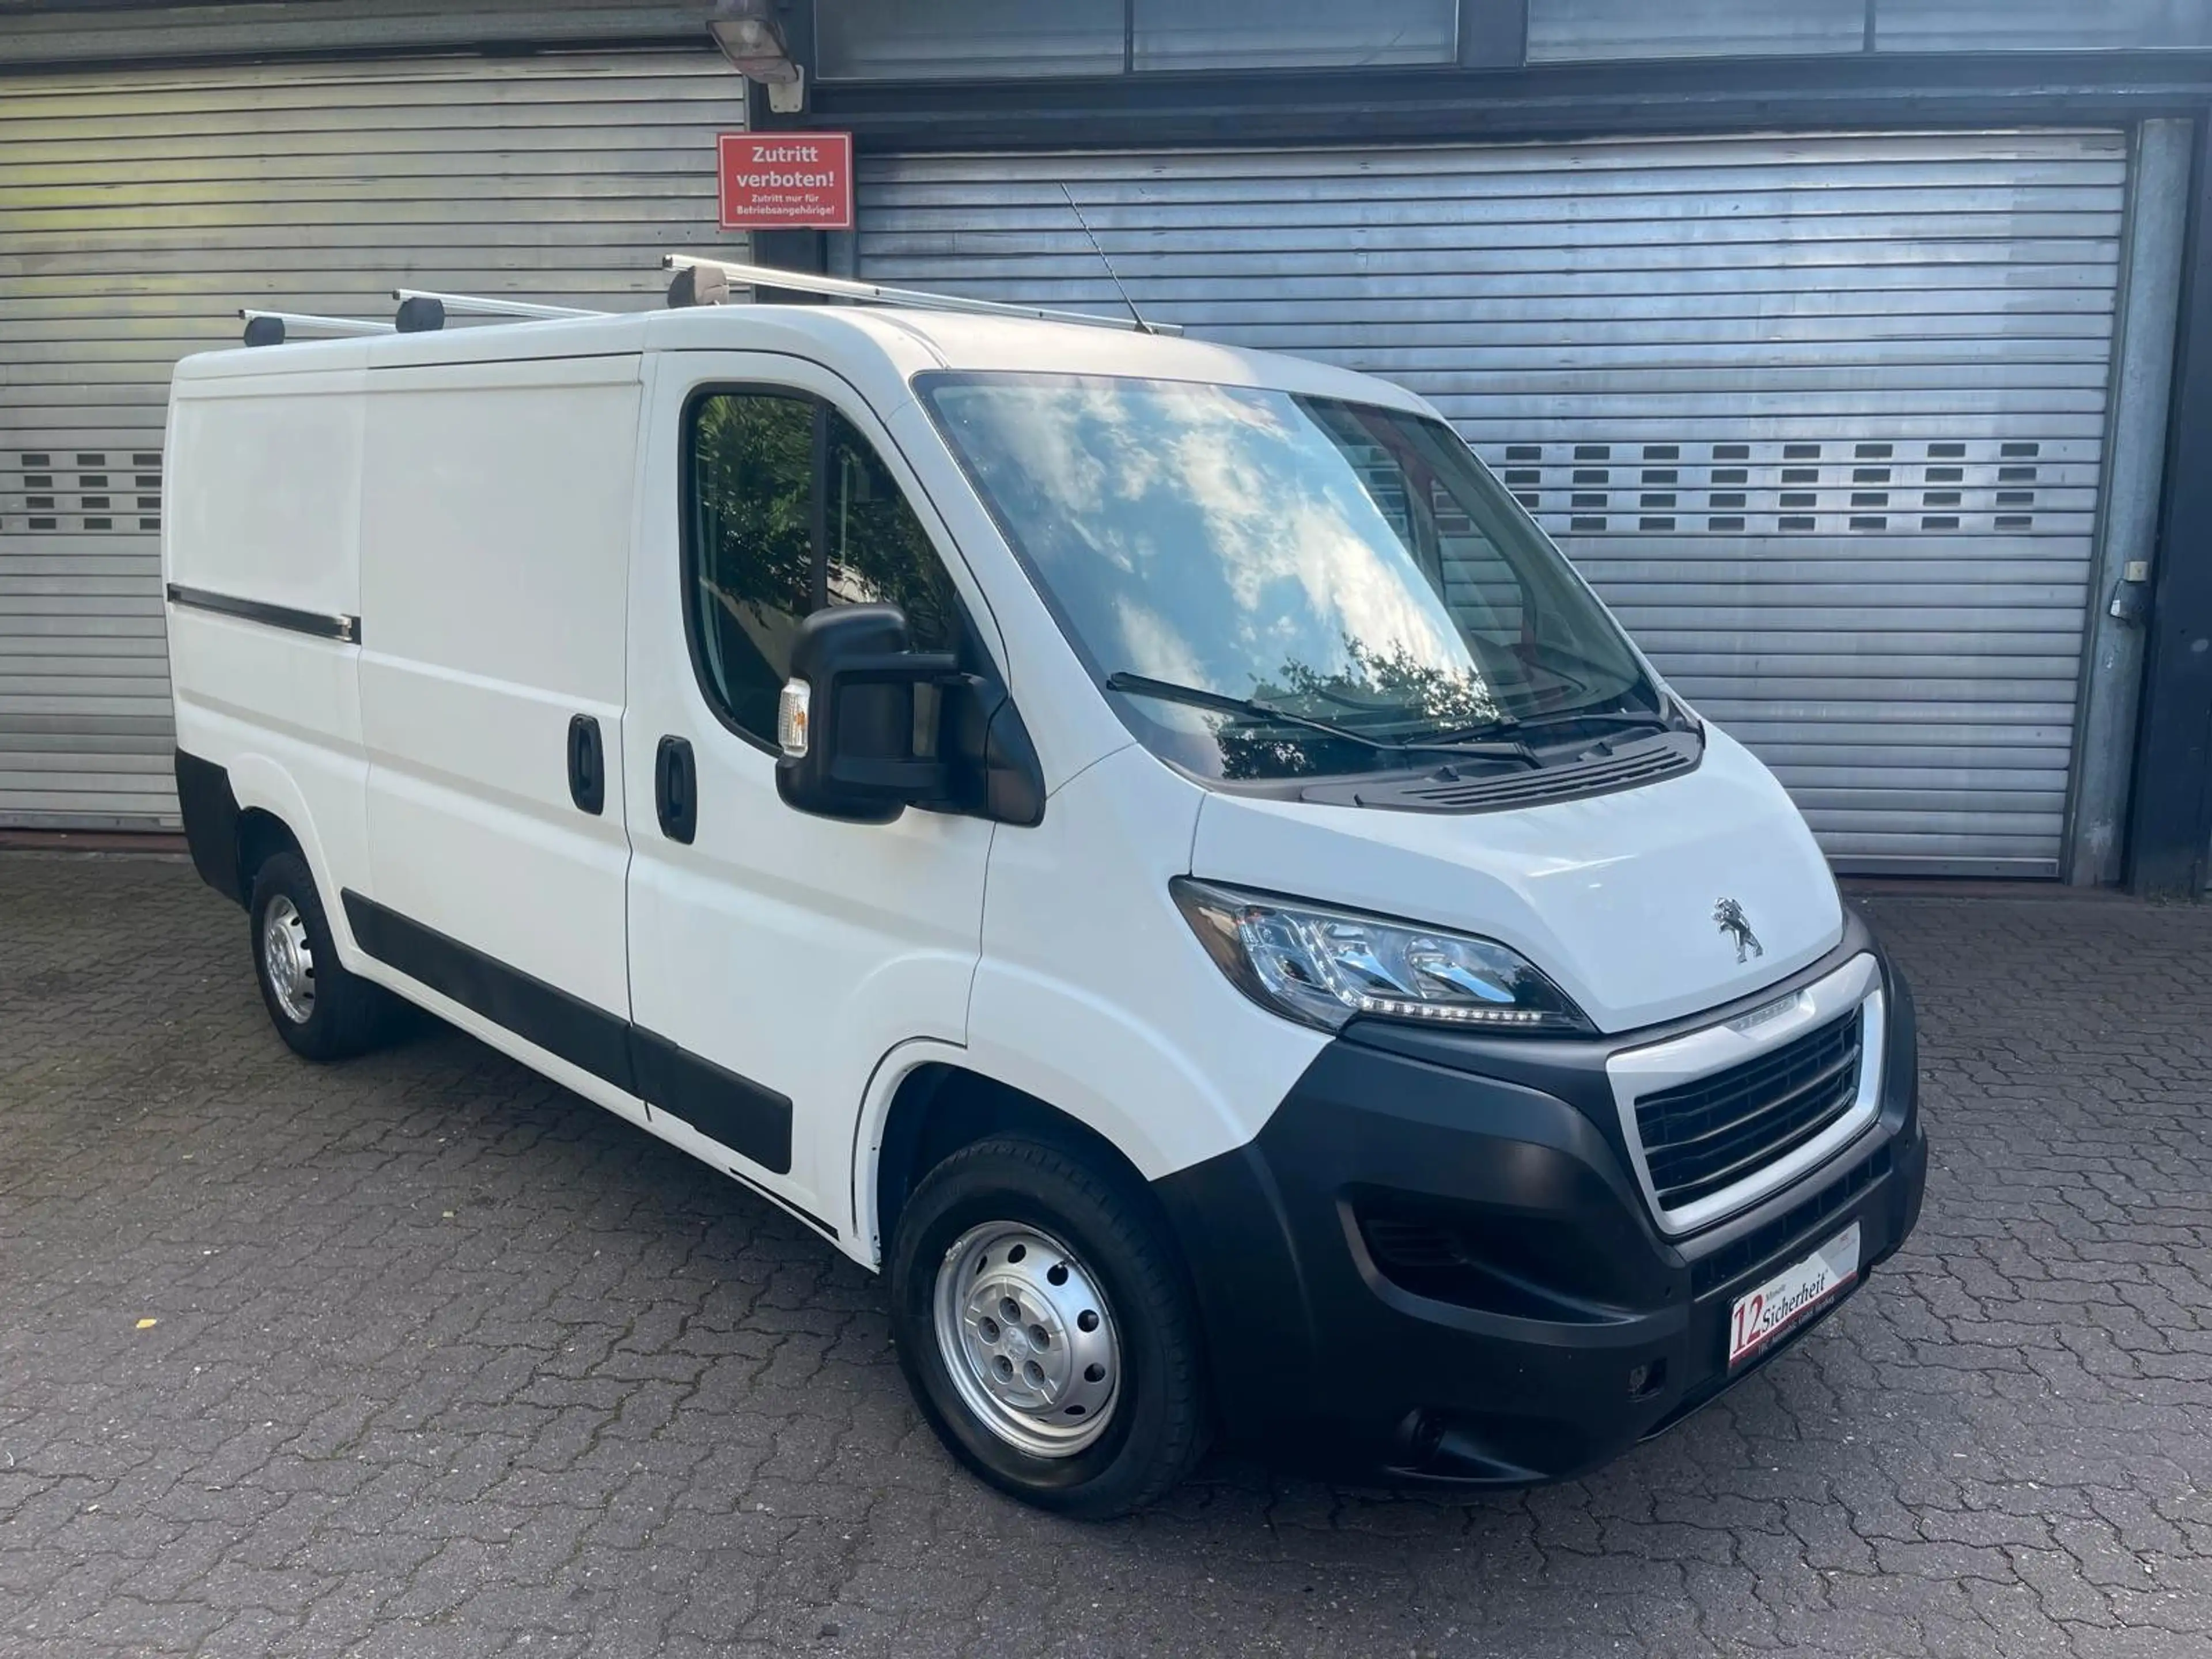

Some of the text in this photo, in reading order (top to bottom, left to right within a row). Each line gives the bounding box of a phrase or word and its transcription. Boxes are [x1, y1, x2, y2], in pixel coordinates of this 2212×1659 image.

[752, 146, 819, 163] Zutritt
[736, 171, 835, 187] verboten!
[752, 194, 783, 202] Zutritt
[805, 194, 819, 202] für
[736, 205, 835, 216] Betriebsangehörige!
[1733, 1294, 1763, 1354] 12
[1762, 1273, 1825, 1332] Sicherheit
